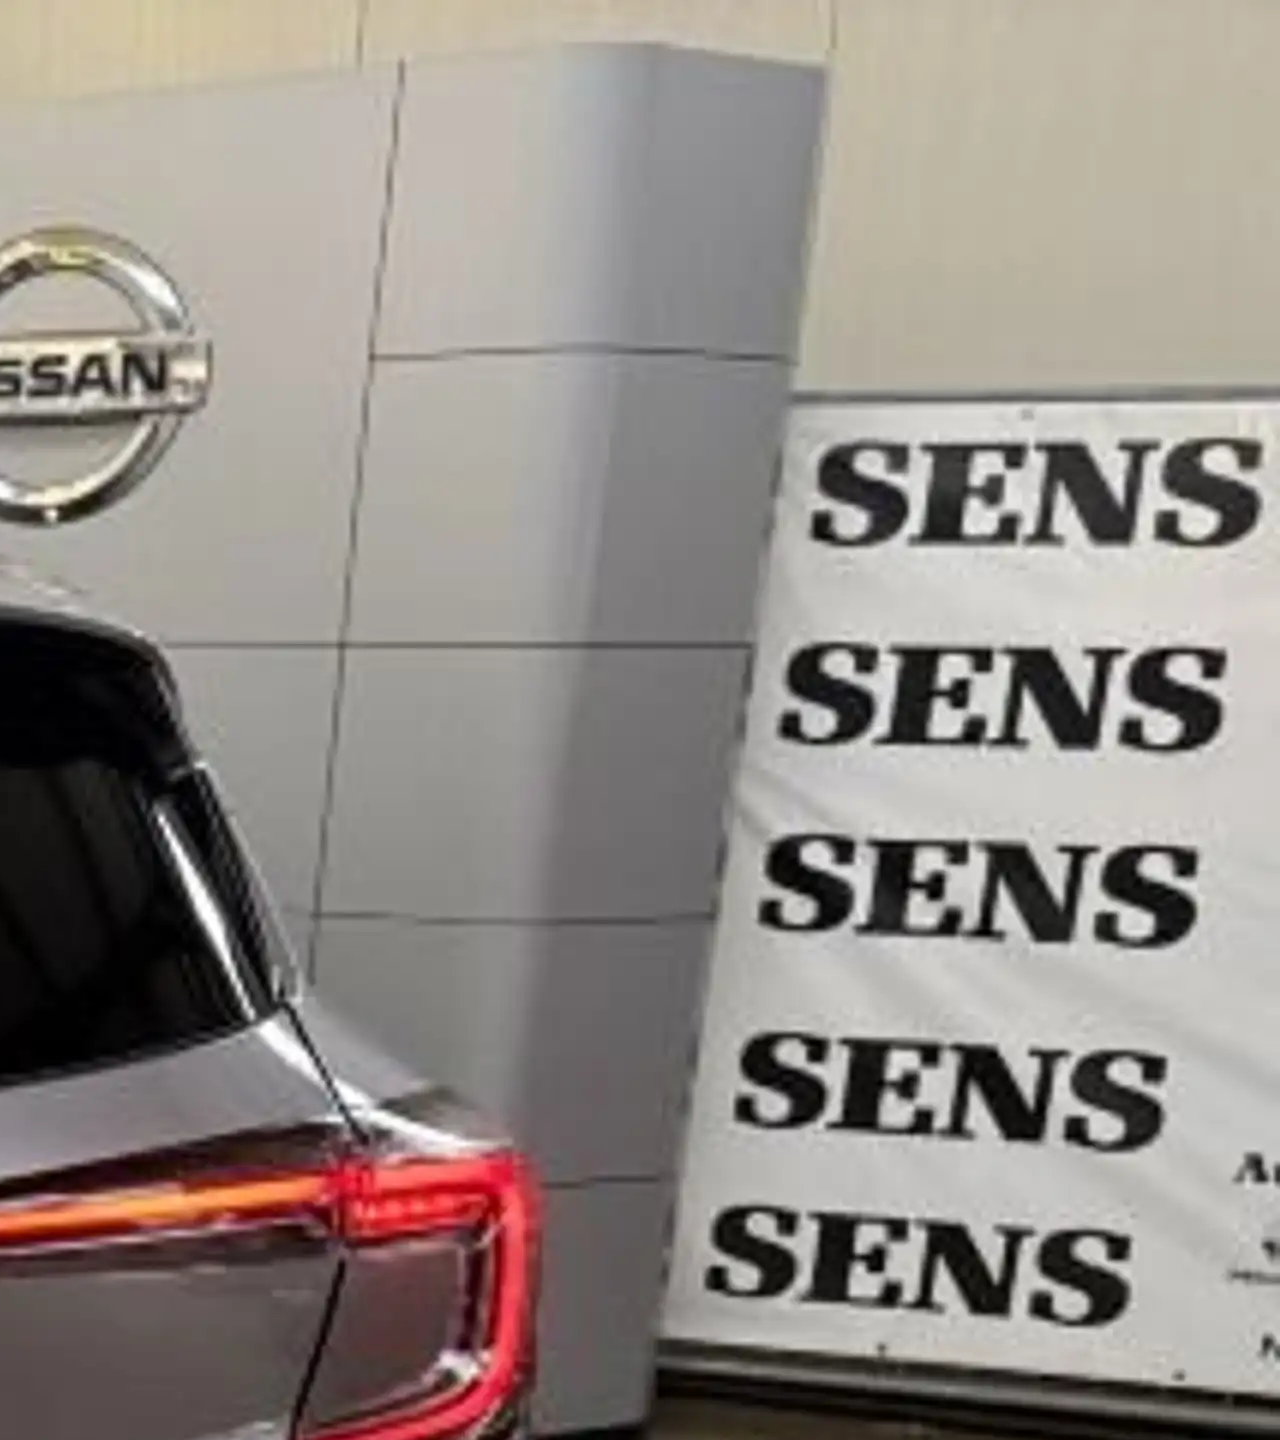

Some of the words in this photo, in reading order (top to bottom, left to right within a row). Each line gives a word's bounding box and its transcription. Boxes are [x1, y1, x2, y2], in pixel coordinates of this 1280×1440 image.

[809, 437, 1263, 548] SENS
[776, 641, 1228, 754] SENS
[757, 832, 1199, 950] SENS
[732, 1030, 1168, 1154] SENS
[703, 1203, 1132, 1329] SENS
